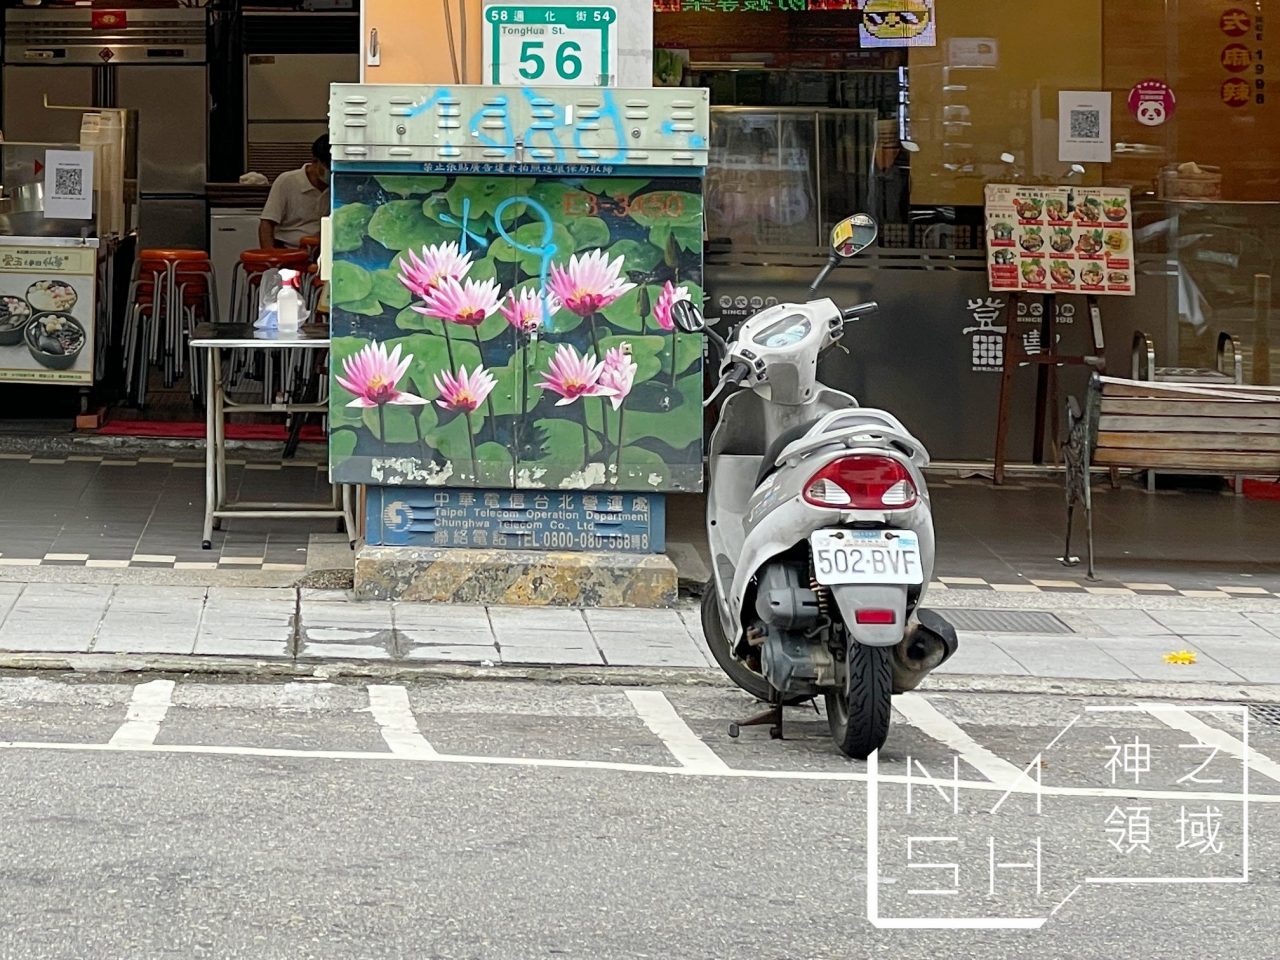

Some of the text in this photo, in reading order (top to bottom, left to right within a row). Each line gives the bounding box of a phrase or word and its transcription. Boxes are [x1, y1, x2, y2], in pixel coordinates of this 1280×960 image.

[491, 10, 508, 20] 58
[593, 10, 610, 21] 54
[501, 26, 565, 36] TongHua St.
[518, 41, 582, 80] 56
[434, 507, 648, 522] Taipei Telecom Operation Department
[434, 518, 490, 529] Chunghwa
[498, 519, 543, 530] Telecom
[433, 530, 507, 546] 聯絡電話
